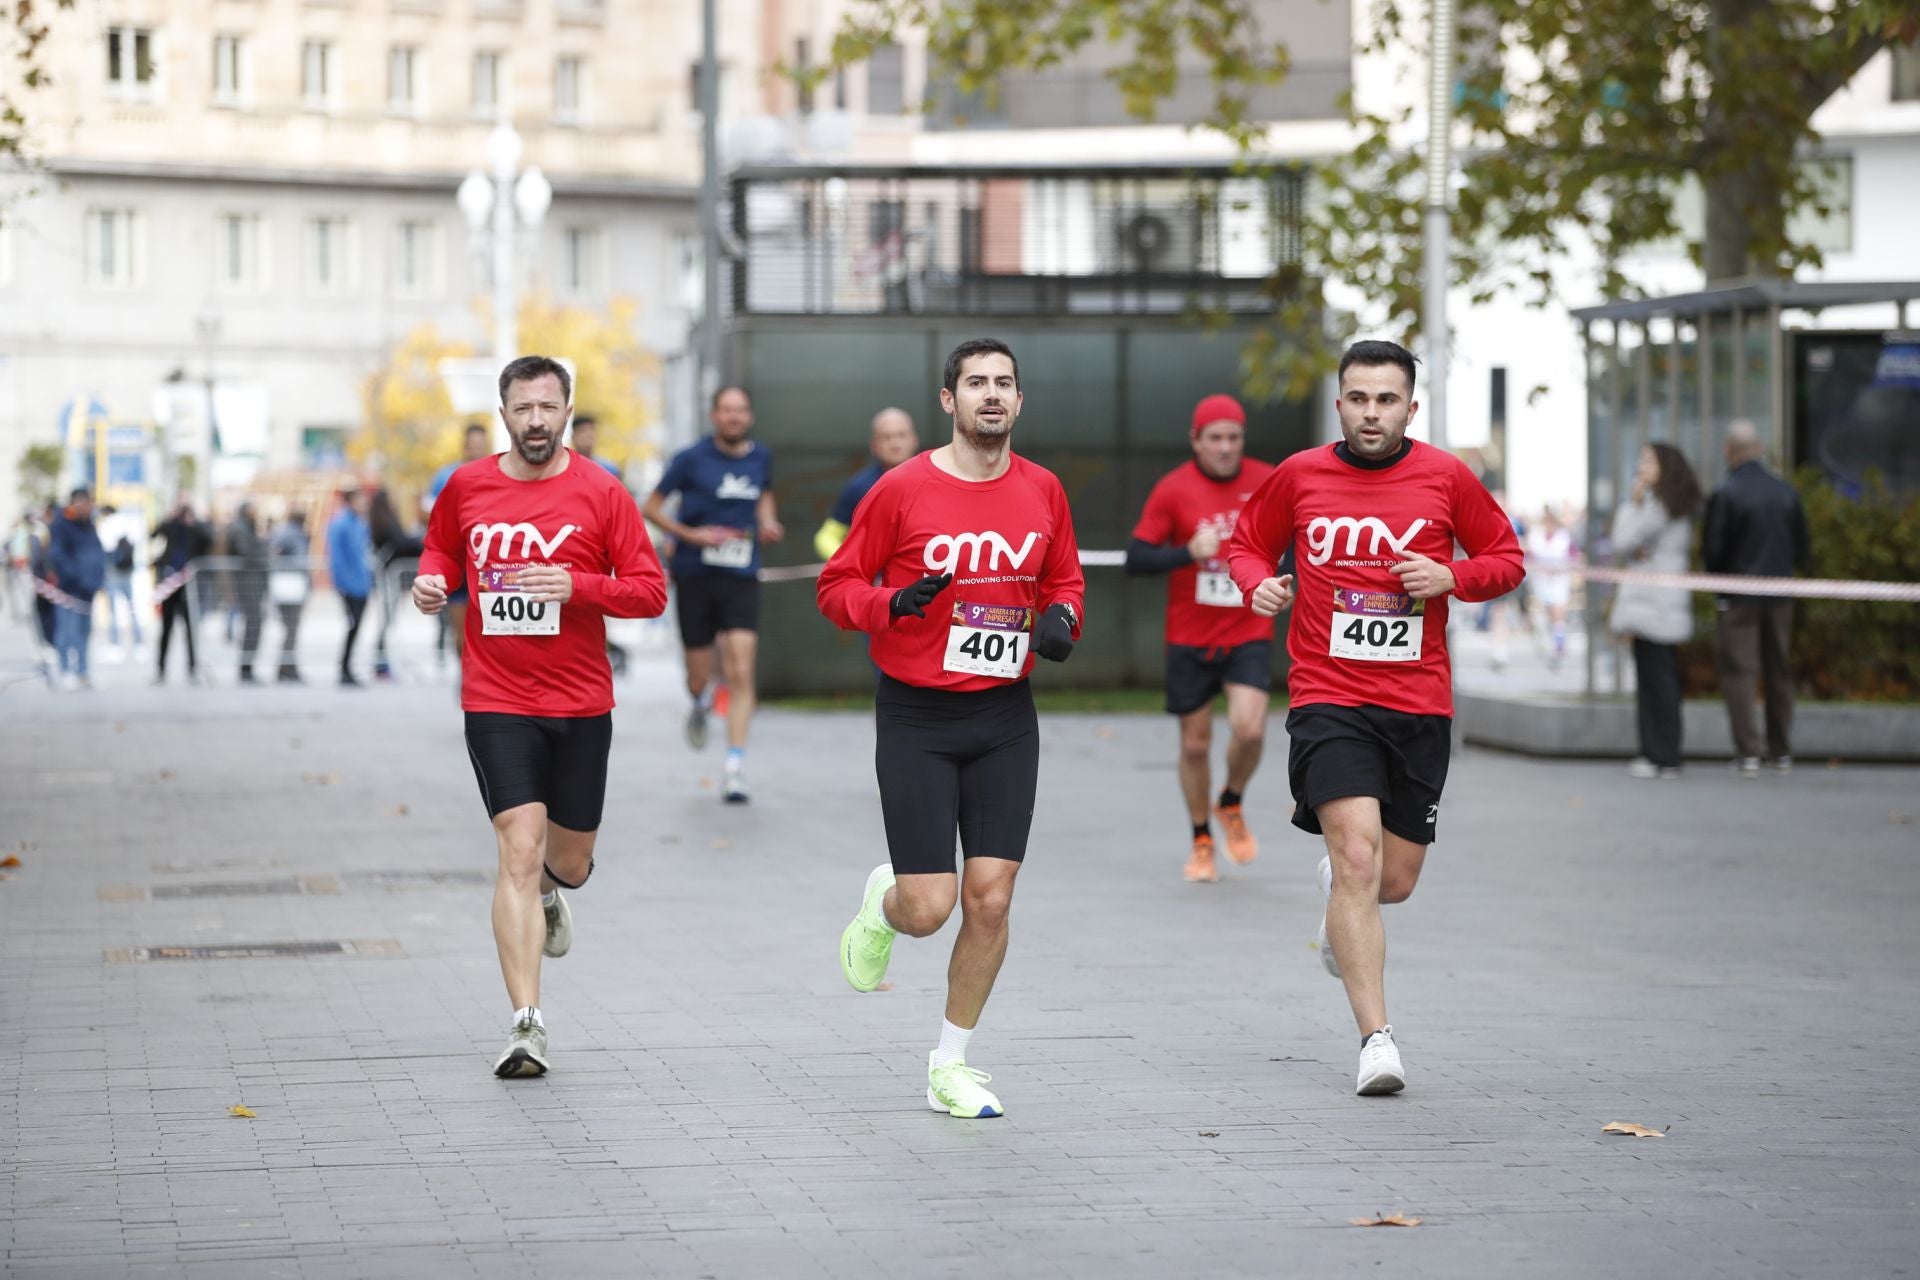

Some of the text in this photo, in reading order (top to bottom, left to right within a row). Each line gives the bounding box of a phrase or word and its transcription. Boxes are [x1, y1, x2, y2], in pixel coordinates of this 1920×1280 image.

[957, 575, 1036, 585] INNOVATING SOLUTIONS
[490, 596, 546, 621] 400
[1363, 600, 1398, 609] EMPRESAS
[983, 613, 1015, 624] EMPRESAS
[1343, 618, 1409, 647] 402
[960, 632, 1018, 664] 401
